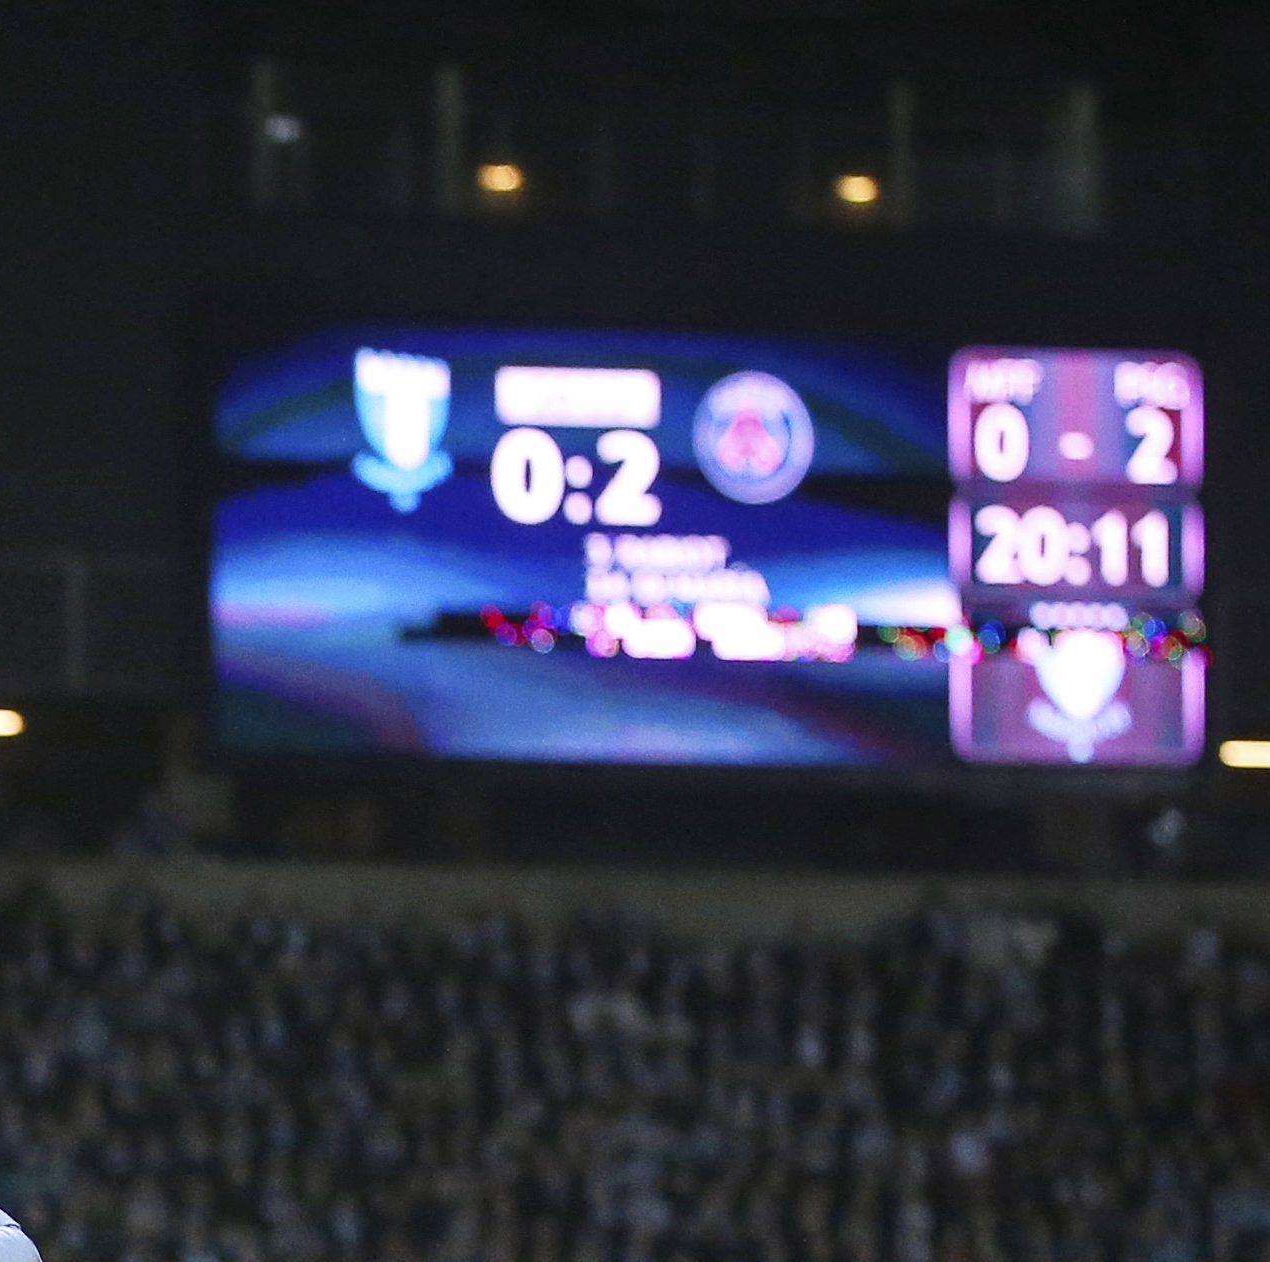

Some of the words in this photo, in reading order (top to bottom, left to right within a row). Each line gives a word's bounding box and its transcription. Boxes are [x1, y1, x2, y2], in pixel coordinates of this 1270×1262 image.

[490, 426, 662, 527] 0:2
[974, 402, 1029, 482] 0
[1126, 406, 1178, 484] 2
[975, 504, 1170, 588] 20:11
